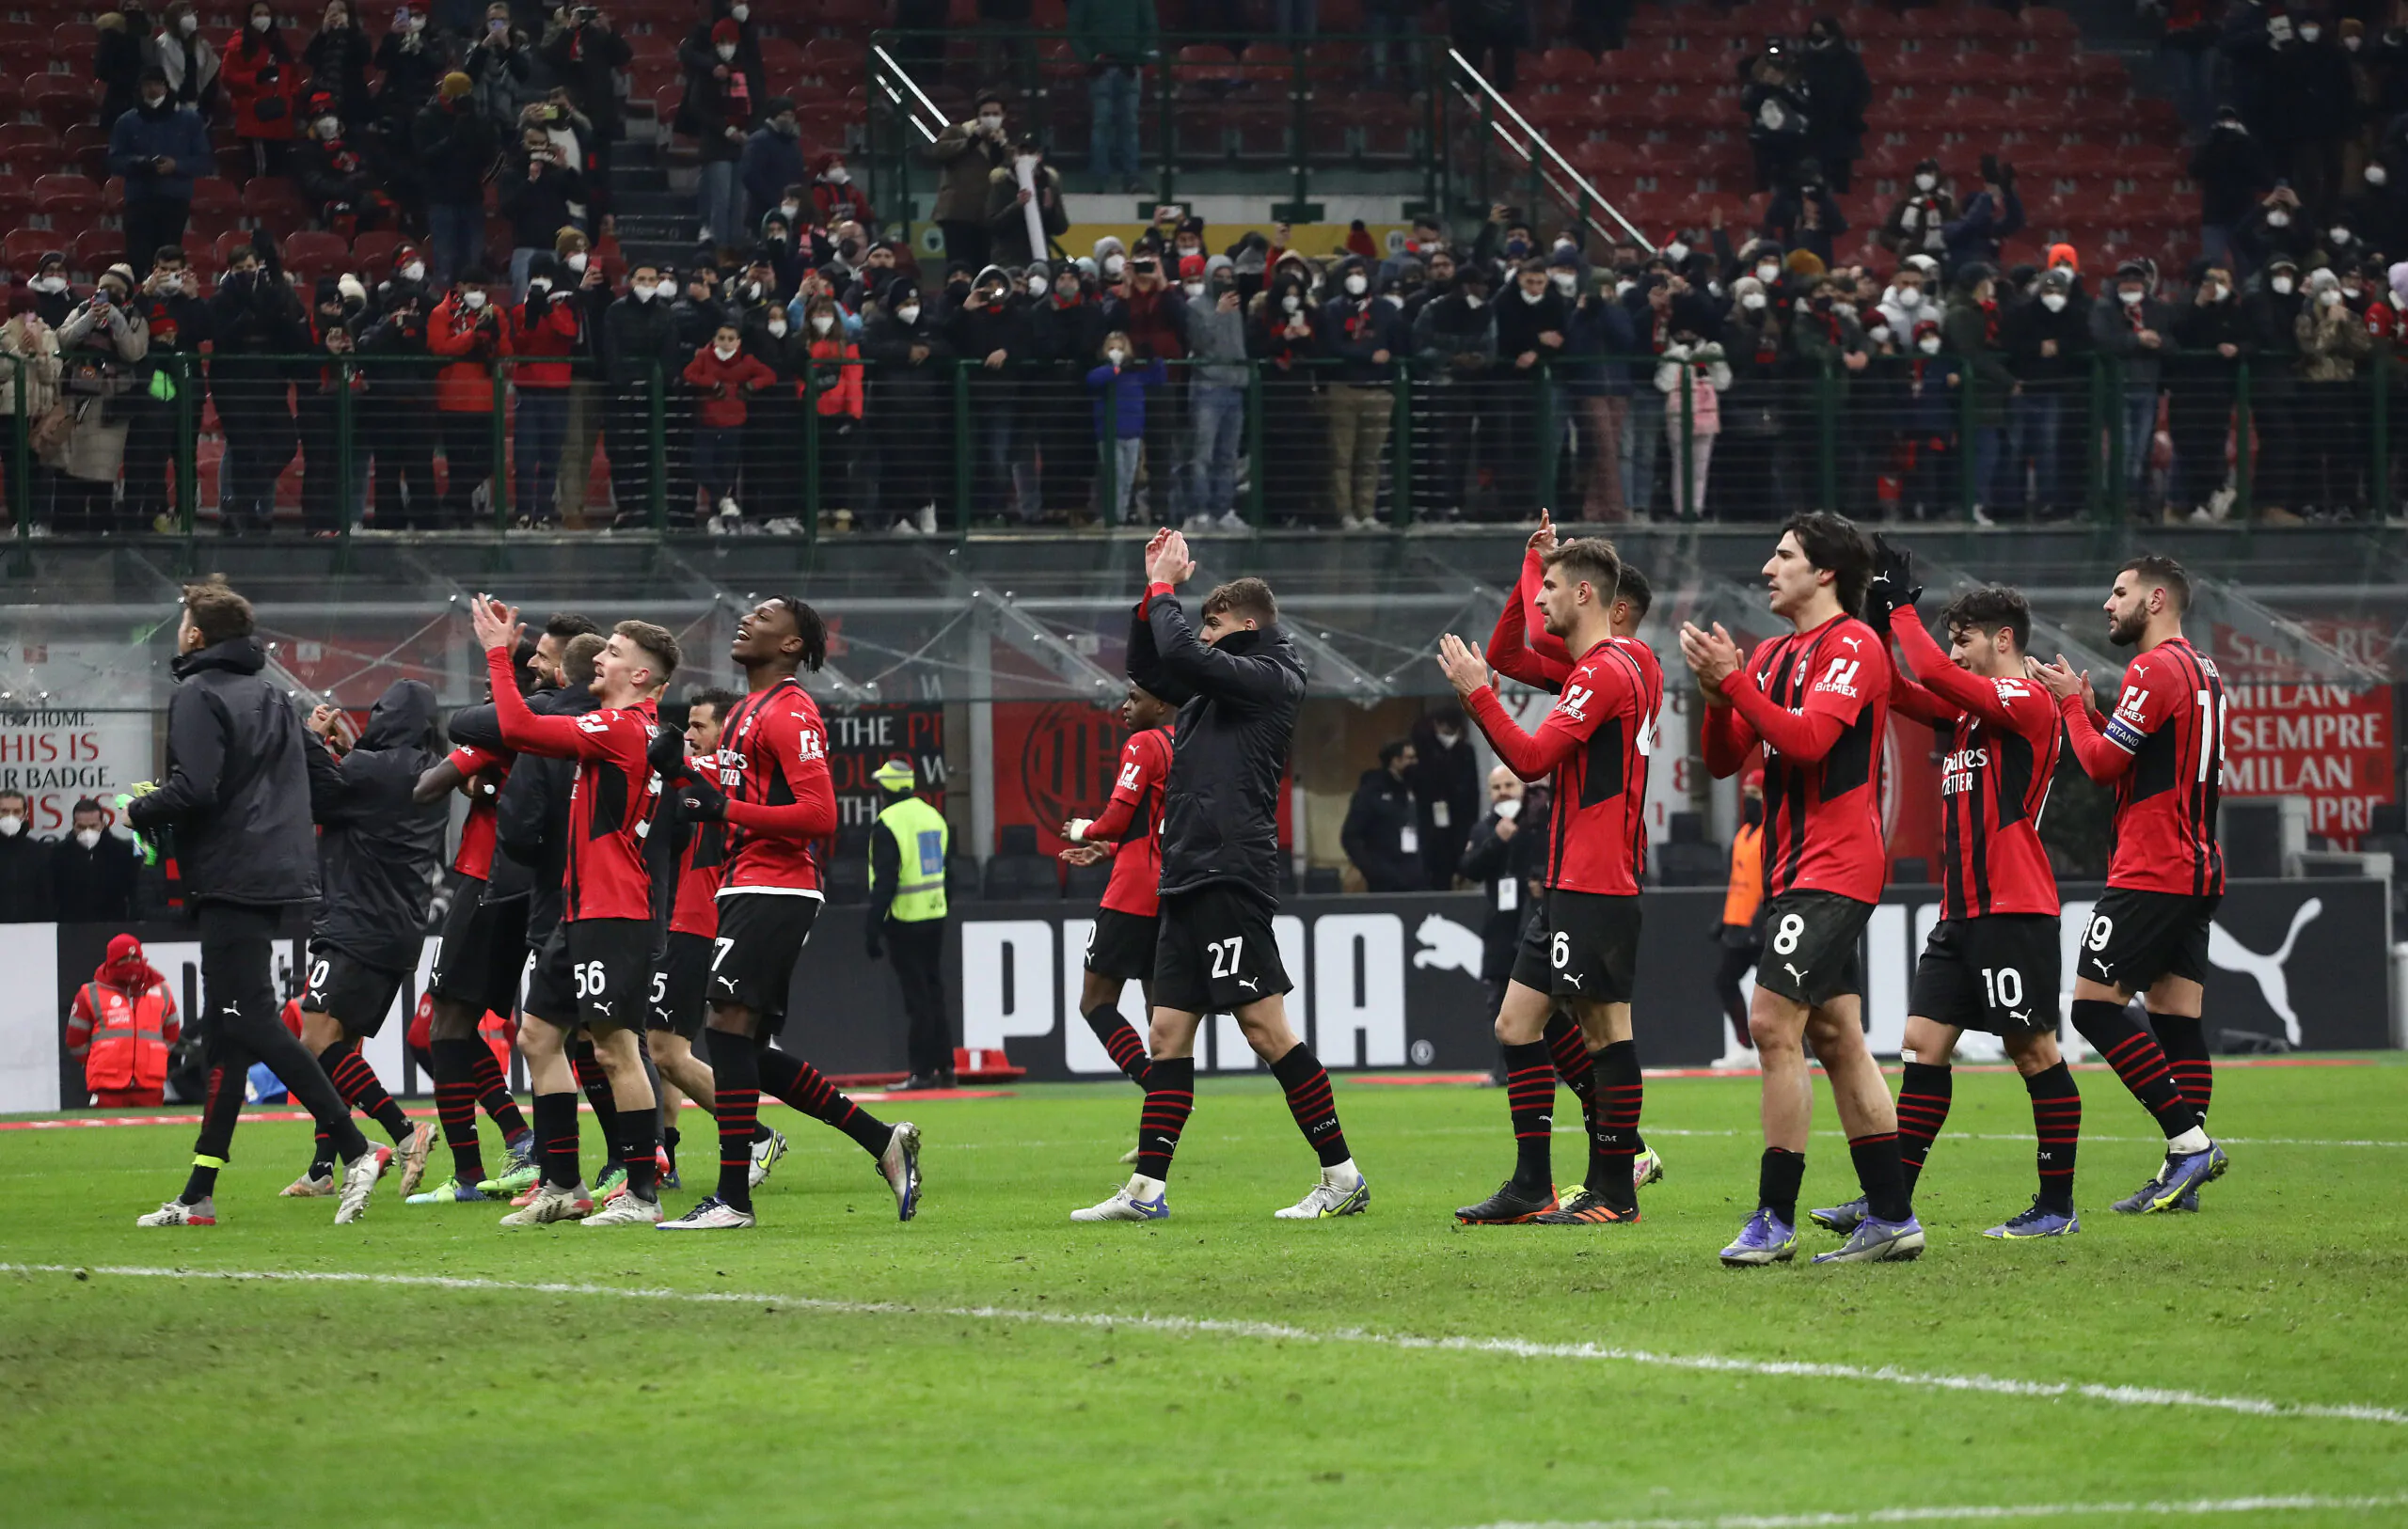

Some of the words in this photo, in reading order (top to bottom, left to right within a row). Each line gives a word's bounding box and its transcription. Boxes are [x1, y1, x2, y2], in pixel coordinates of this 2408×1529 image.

[2227, 626, 2380, 666] SERE
[1814, 681, 1858, 698] BitMEX
[0, 733, 57, 763] HIS
[70, 732, 99, 763] IS
[834, 716, 895, 747] THE
[2107, 721, 2139, 747] APITANO
[2230, 712, 2384, 751] SEMPRE
[26, 766, 116, 790] BADGE.
[2223, 754, 2353, 793] MILAN
[1773, 913, 1805, 955] 8
[711, 937, 735, 972] 7
[1207, 937, 1243, 979] 27
[574, 960, 606, 1000] 56
[1981, 968, 2023, 1010] 10
[1313, 1117, 1337, 1134] ACM
